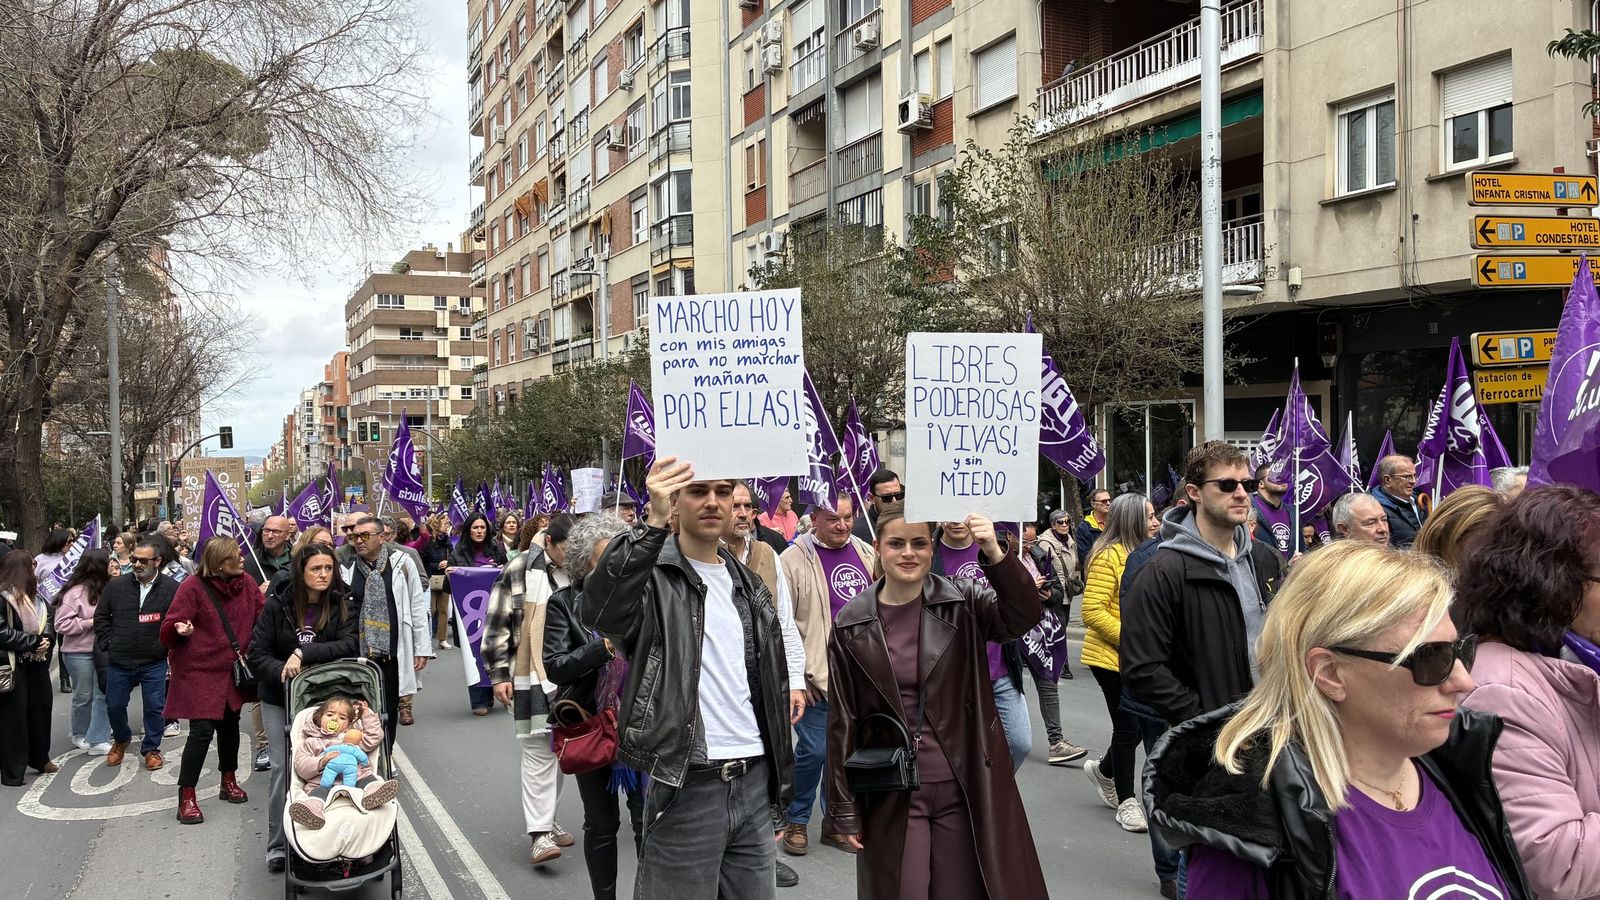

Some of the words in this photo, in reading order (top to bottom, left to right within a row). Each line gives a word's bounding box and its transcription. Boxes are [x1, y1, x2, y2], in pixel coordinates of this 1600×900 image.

[1475, 178, 1502, 187] HOTEL
[1475, 190, 1511, 199] INFANTA
[1514, 190, 1551, 200] CRISTINA
[1570, 222, 1598, 232] HOTEL
[1535, 233, 1599, 244] CONDESTABLE
[1572, 259, 1600, 269] HTEL
[657, 299, 740, 334] MARCHO
[749, 297, 795, 333] HOY
[660, 340, 688, 353] con
[697, 337, 726, 351] mis
[732, 336, 786, 356] amigas
[662, 357, 699, 376] para
[709, 355, 727, 367] no
[737, 349, 800, 366] marchar
[911, 343, 1018, 386] LIBRES
[694, 370, 769, 387] mañana
[1521, 372, 1532, 381] de
[1480, 385, 1543, 401] ferrocarril
[663, 391, 707, 430] POR
[719, 389, 801, 431] ELLAS!
[913, 386, 1037, 422] PODEROSAS
[927, 422, 1019, 456] ¡VIVAS!
[953, 457, 961, 470] y
[964, 456, 983, 466] sin
[183, 475, 199, 485] 10
[940, 471, 1007, 497] MIEDO
[839, 572, 856, 581] UGT
[139, 614, 154, 622] UGT
